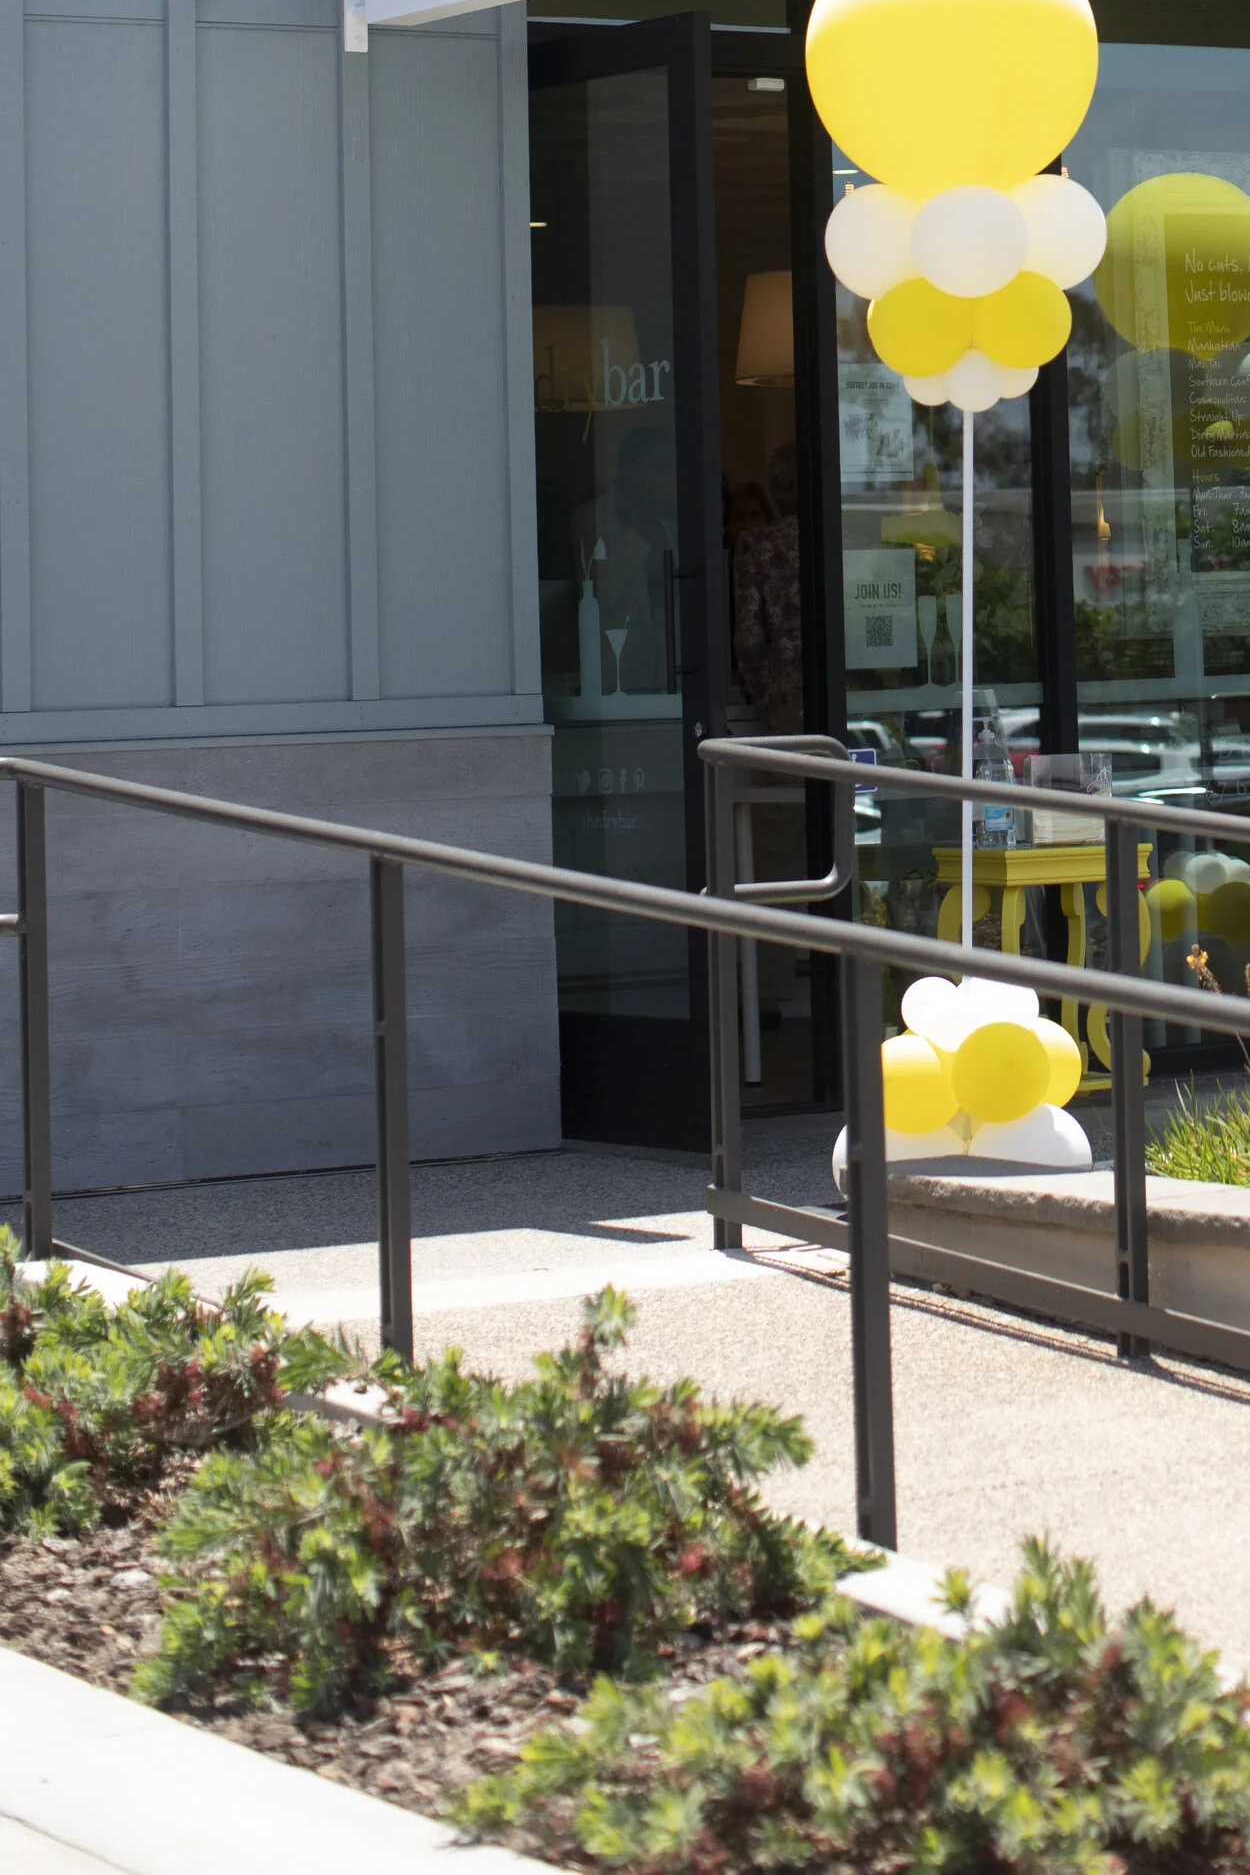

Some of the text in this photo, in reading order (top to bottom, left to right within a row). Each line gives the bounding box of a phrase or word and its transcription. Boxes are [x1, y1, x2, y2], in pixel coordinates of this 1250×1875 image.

[1185, 247, 1204, 273] No
[1208, 253, 1243, 273] cuts.
[1185, 280, 1216, 304] Just
[1188, 373, 1228, 388] Southern
[1190, 409, 1230, 423] Straight
[1190, 444, 1206, 458] Old
[1192, 468, 1221, 484] Hours
[854, 582, 901, 599] JOIN US!
